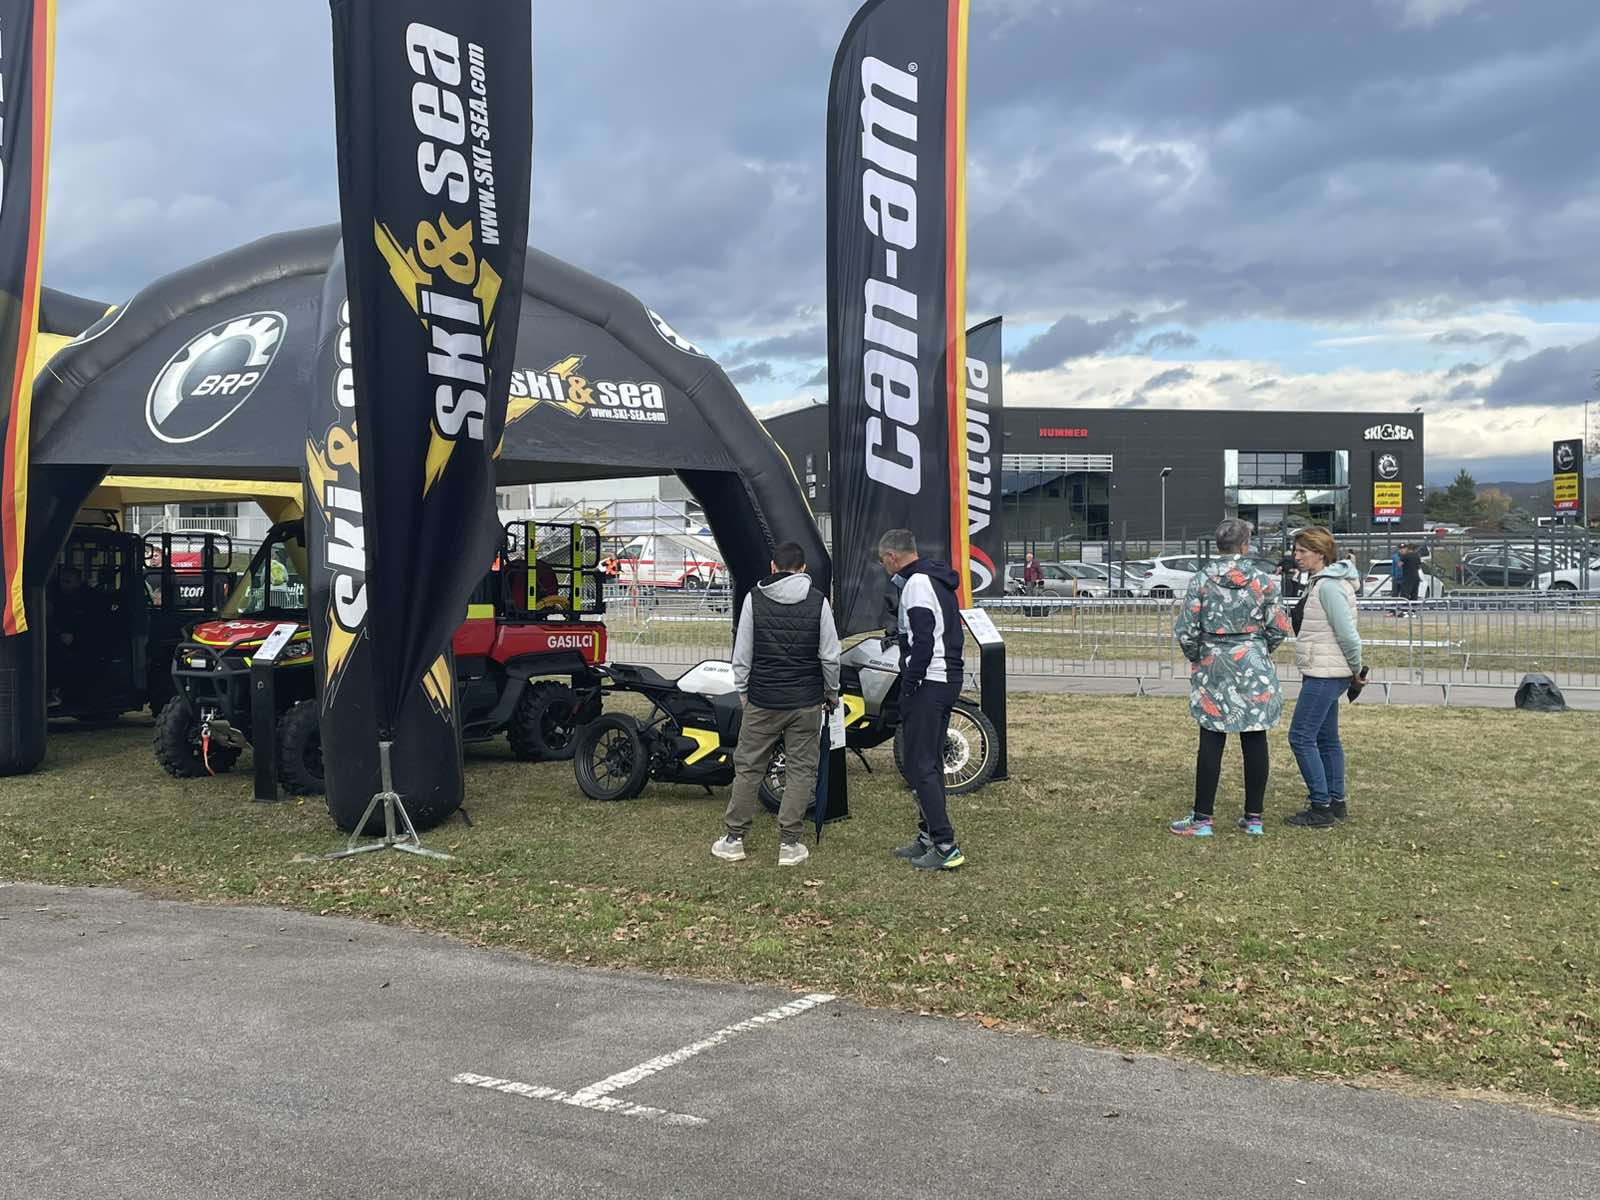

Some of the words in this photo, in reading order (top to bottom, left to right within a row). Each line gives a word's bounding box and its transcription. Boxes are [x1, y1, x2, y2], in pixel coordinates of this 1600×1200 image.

[406, 22, 470, 204] sea
[468, 42, 500, 245] www.SKI-SEA.com
[860, 55, 921, 496] can-am
[190, 371, 260, 396] BRP
[421, 290, 486, 441] ski
[509, 370, 565, 401] ski
[597, 382, 665, 409] sea
[547, 635, 593, 649] GASILCI
